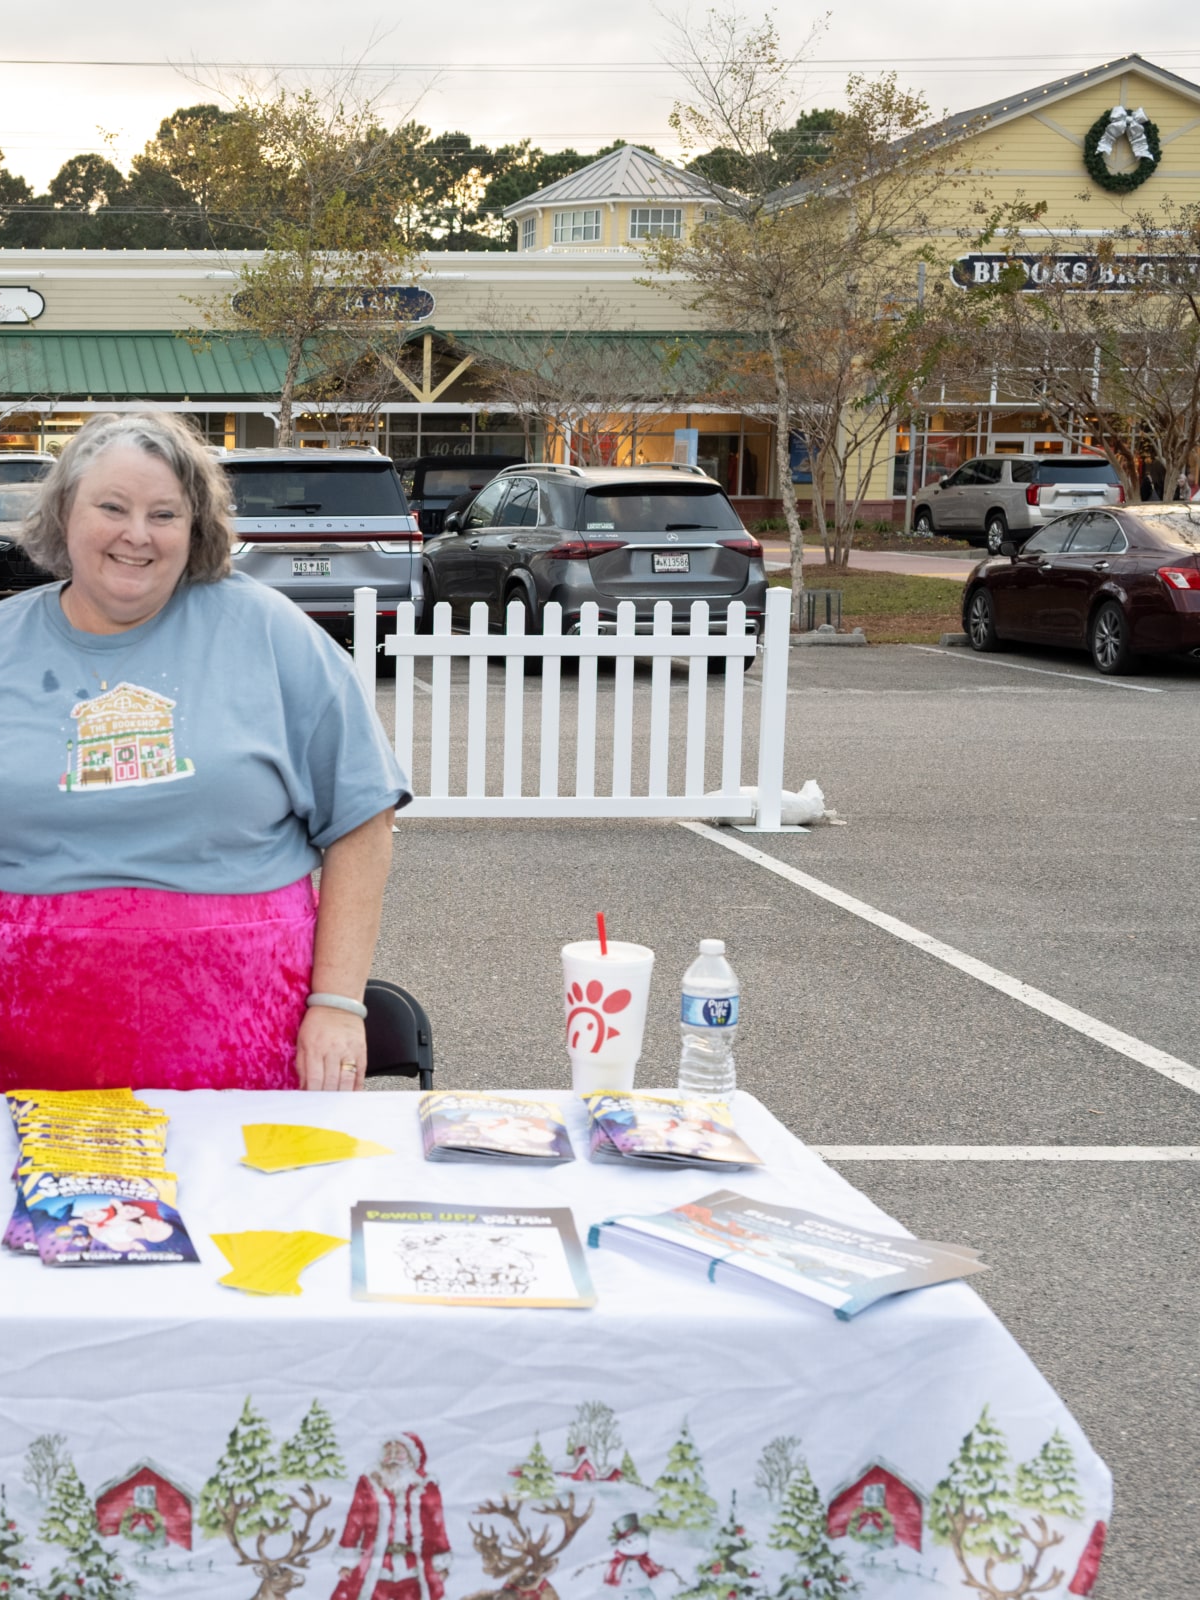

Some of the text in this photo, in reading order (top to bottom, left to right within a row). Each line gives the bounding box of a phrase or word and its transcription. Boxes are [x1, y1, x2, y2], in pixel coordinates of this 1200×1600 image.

[294, 562, 329, 572] 943 ABG
[89, 722, 106, 734] THE
